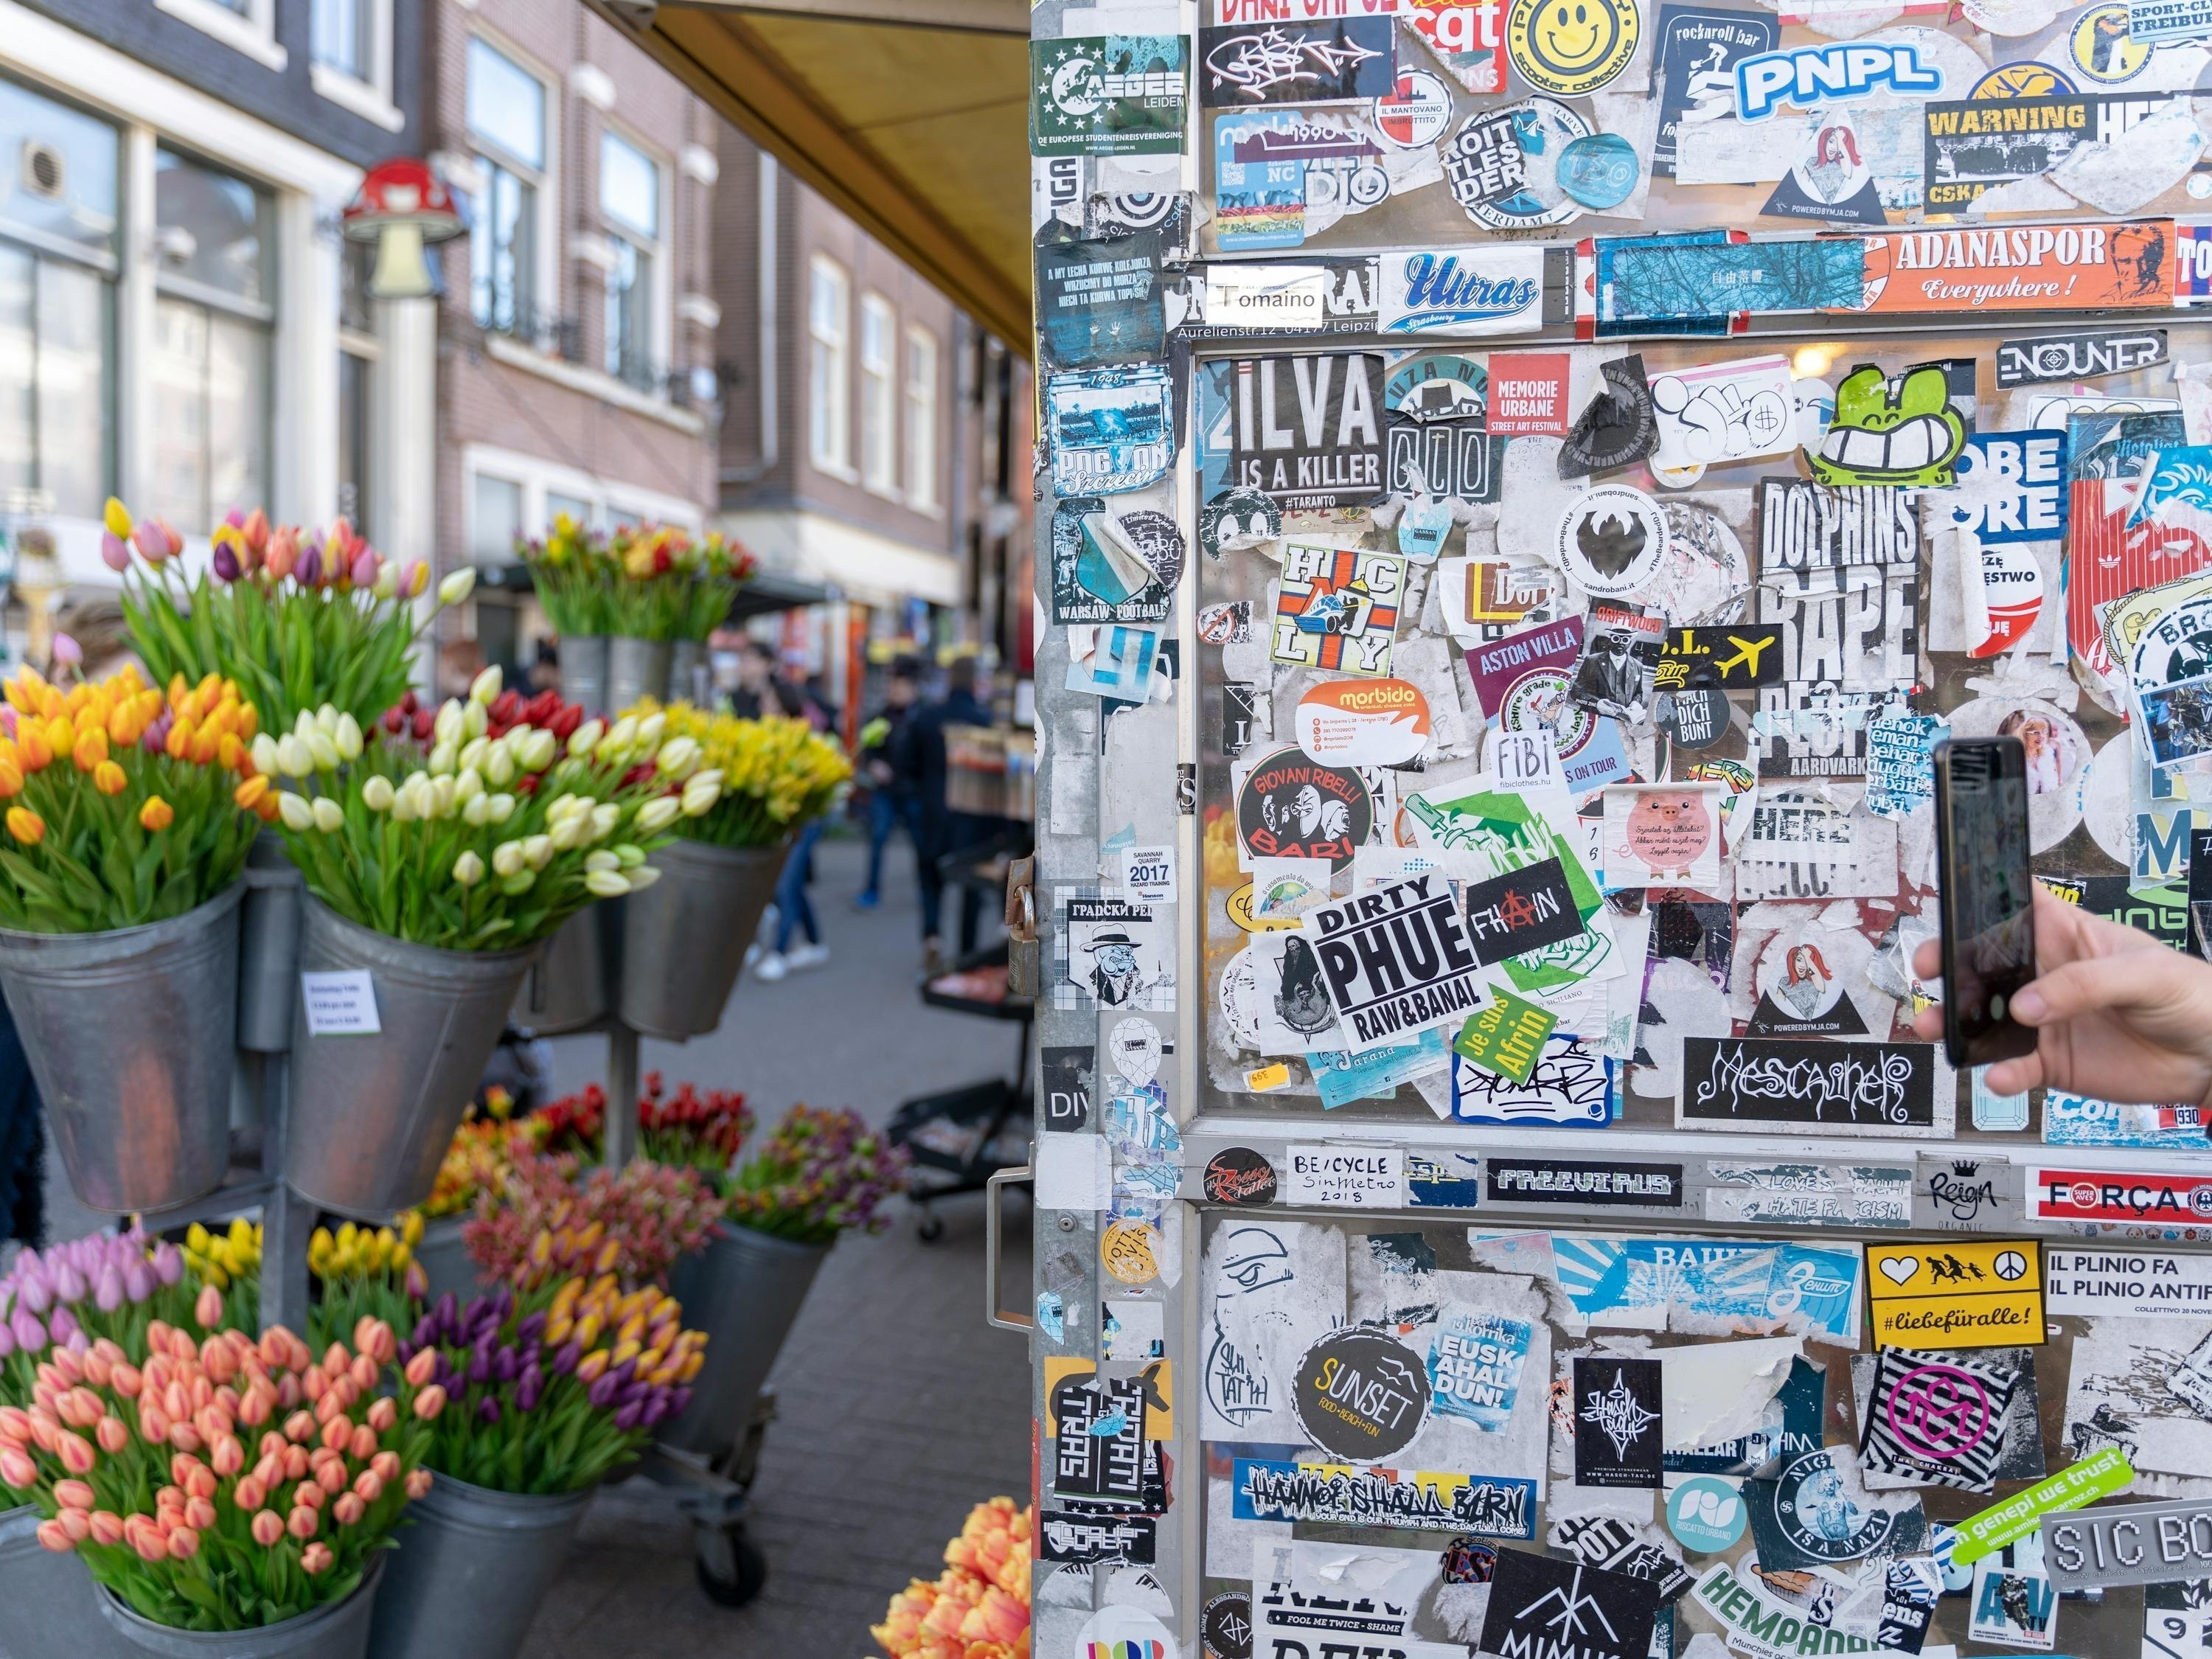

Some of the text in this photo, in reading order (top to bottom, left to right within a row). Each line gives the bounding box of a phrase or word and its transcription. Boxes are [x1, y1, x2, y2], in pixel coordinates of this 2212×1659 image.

[1676, 23, 1760, 48] rocknroll bar
[1515, 39, 1634, 91] scooter collective
[1085, 72, 1184, 98] AEGEE
[1745, 48, 1934, 111] PNPL
[1144, 97, 1184, 108] LEIDEN
[1928, 105, 2085, 136] WARNING
[1048, 134, 1084, 143] EUROPESE
[1085, 131, 1183, 142] STUDENTENREISVERENIGING
[1267, 166, 1295, 184] NC
[1792, 205, 1859, 218] POWEREDBYMJA.COM
[1895, 228, 2107, 270] ADANASPOR
[1048, 269, 1053, 280] A
[1055, 267, 1065, 278] MY
[1068, 265, 1088, 276] LECHA
[1115, 257, 1151, 272] KOLEJORZA
[1064, 274, 1137, 293] WRZUCIMY DO MORZA
[1404, 252, 1540, 310] Ultras
[1921, 274, 2059, 305] Everywhere
[1059, 289, 1133, 307] NIECH TA KURWA TOPI
[1091, 374, 1121, 385] 1948
[1498, 380, 1558, 398] MEMORIE
[1238, 355, 1380, 452] ILVA
[1500, 399, 1554, 417] URBANE
[1491, 421, 1562, 431] STREET ART FESTIVAL
[1241, 453, 1381, 490] IS A KILLER
[1285, 495, 1335, 509] #TARANTO
[1587, 490, 1638, 501] sandrobani.it
[1762, 482, 1916, 568] DOLPHINS
[1583, 582, 1635, 593] sandrobani.it
[1059, 604, 1166, 619] WARSAW FOOTBALL
[1597, 607, 1663, 633] DRIFTWOOD
[1480, 627, 1577, 676] ASTON VILLA
[1340, 686, 1416, 709] morbido
[1677, 703, 1710, 725] DICH
[1680, 722, 1711, 742] BUNT
[1576, 757, 1617, 780] ON TOUR
[1791, 757, 1866, 776] AARDVARK
[1254, 767, 1362, 804] GIOVANI RIBELLI
[1500, 779, 1551, 787] fibiclothes.hu
[1249, 828, 1354, 858] BARI
[1130, 865, 1169, 882] 2017
[1315, 874, 1430, 935] DIRTY
[1317, 900, 1475, 1009] PHUE
[1352, 975, 1481, 1043] RAW&BANAL
[1464, 995, 1509, 1057] Je suis
[1774, 1022, 1840, 1032] POWEREDBYMJA.COM
[1495, 1009, 1549, 1077] Afrin
[2175, 1110, 2199, 1124] 1930
[1321, 1192, 1363, 1202] 2018
[1929, 1171, 1997, 1220] Reign
[2073, 1189, 2095, 1197] SUPER
[1769, 1197, 1818, 1216] HATE
[2051, 1256, 2179, 1274] IL PLINIO FA
[2050, 1280, 2144, 1297] IL PLINIO
[1884, 1307, 2031, 1333] #liebefüralle!
[1441, 1335, 1517, 1369] EUSK
[1433, 1354, 1509, 1390] AHAL
[1315, 1357, 1413, 1430] SUNSET
[1434, 1373, 1504, 1408] DUN!
[1318, 1397, 1380, 1439] FOOD BEACH FUN
[1972, 1495, 2036, 1539] genepi
[2067, 1453, 2121, 1486] trust
[1421, 1520, 1439, 1528] AND
[1676, 1519, 1732, 1541] RISCATTO URBANO
[2054, 1520, 2144, 1571] SIC
[1287, 1615, 1401, 1633] FOOL ME TWICE SHAME
